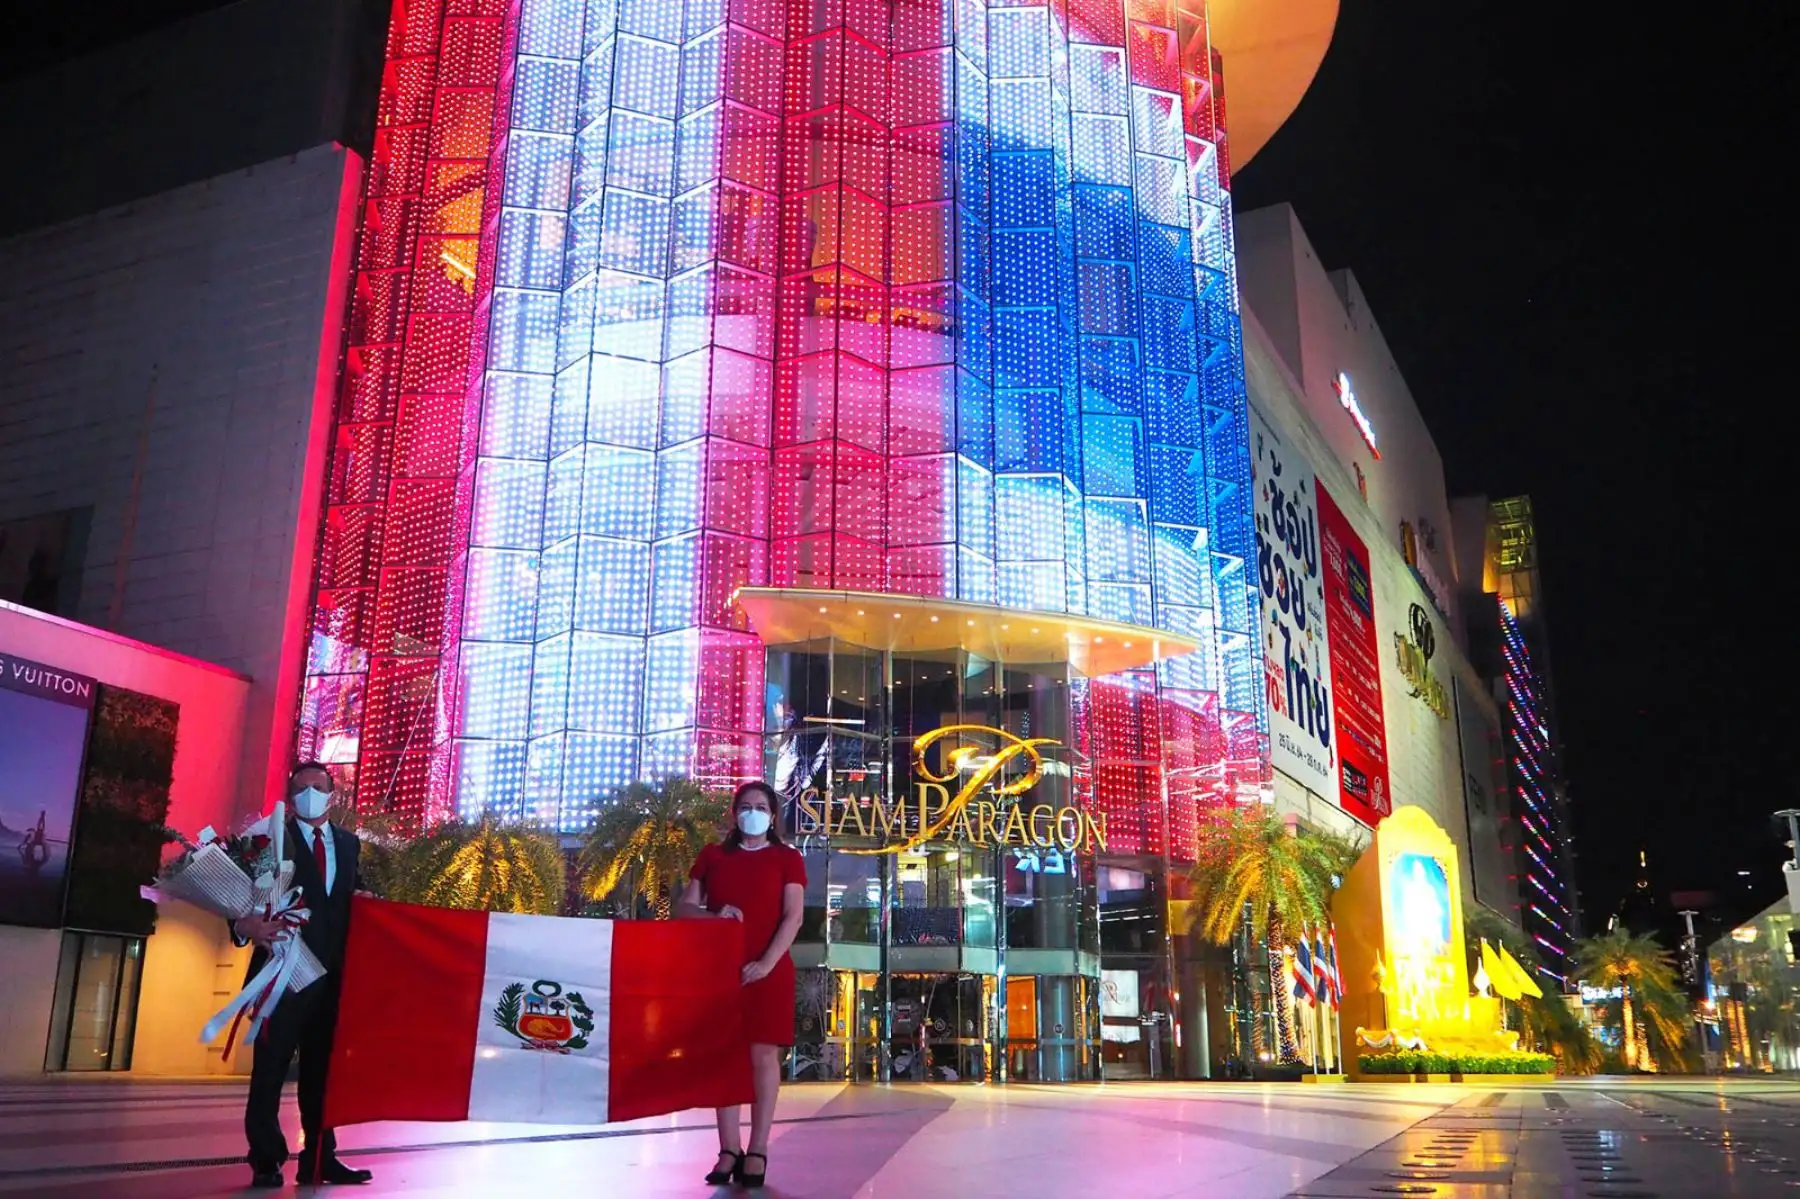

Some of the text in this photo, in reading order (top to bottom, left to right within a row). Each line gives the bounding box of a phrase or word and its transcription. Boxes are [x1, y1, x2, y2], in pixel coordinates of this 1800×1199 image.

[12, 662, 91, 699] VUITTON
[1279, 620, 1331, 749] ไทย
[798, 781, 1108, 853] SIAM PARAGON
